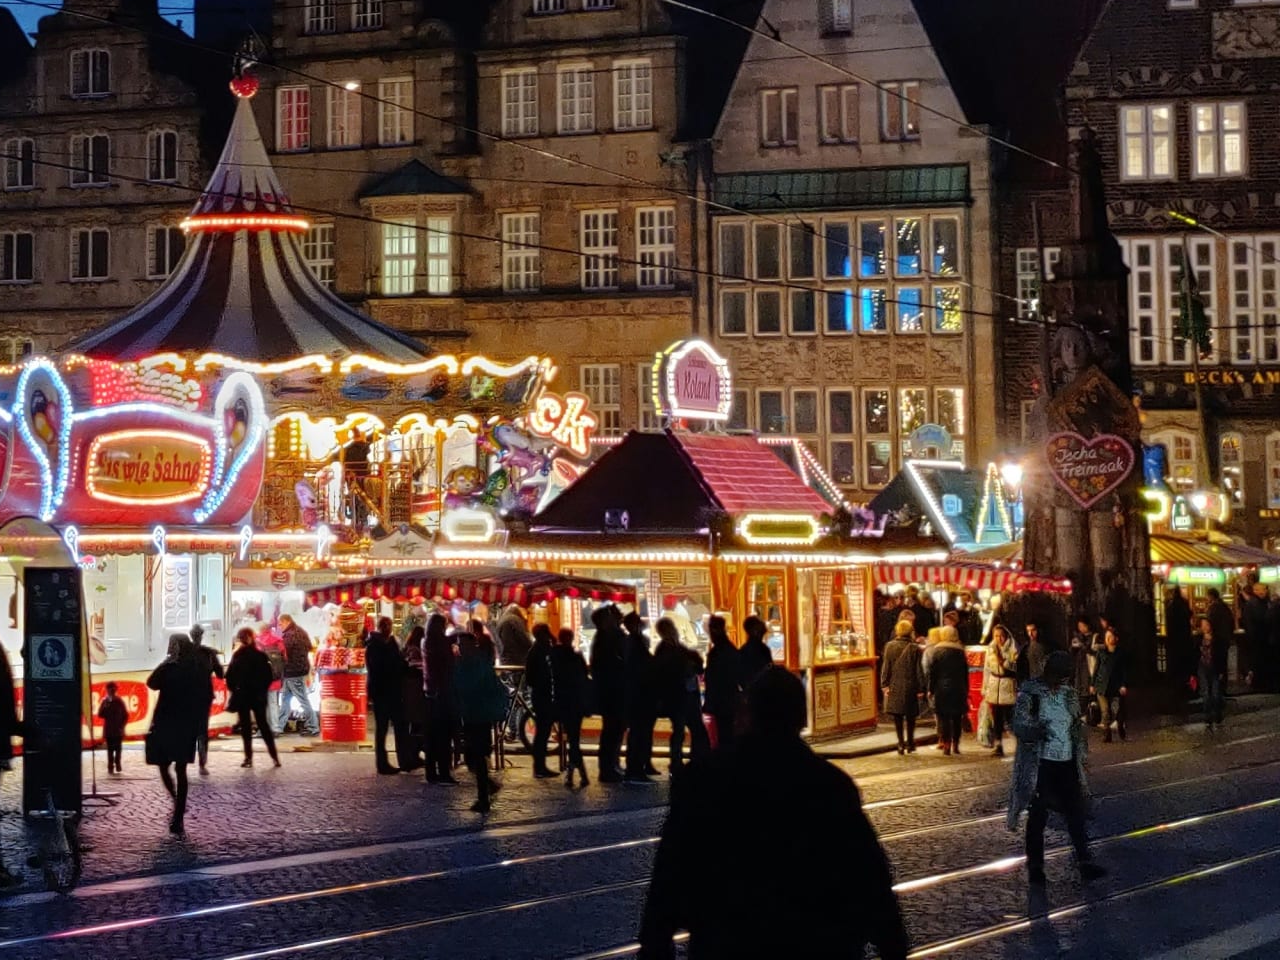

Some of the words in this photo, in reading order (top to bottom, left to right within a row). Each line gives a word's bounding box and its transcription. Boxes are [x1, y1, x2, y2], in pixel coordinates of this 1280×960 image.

[683, 370, 712, 401] Roland
[123, 452, 150, 485] wie
[152, 452, 200, 485] Sahne
[1060, 456, 1125, 478] Freimaak
